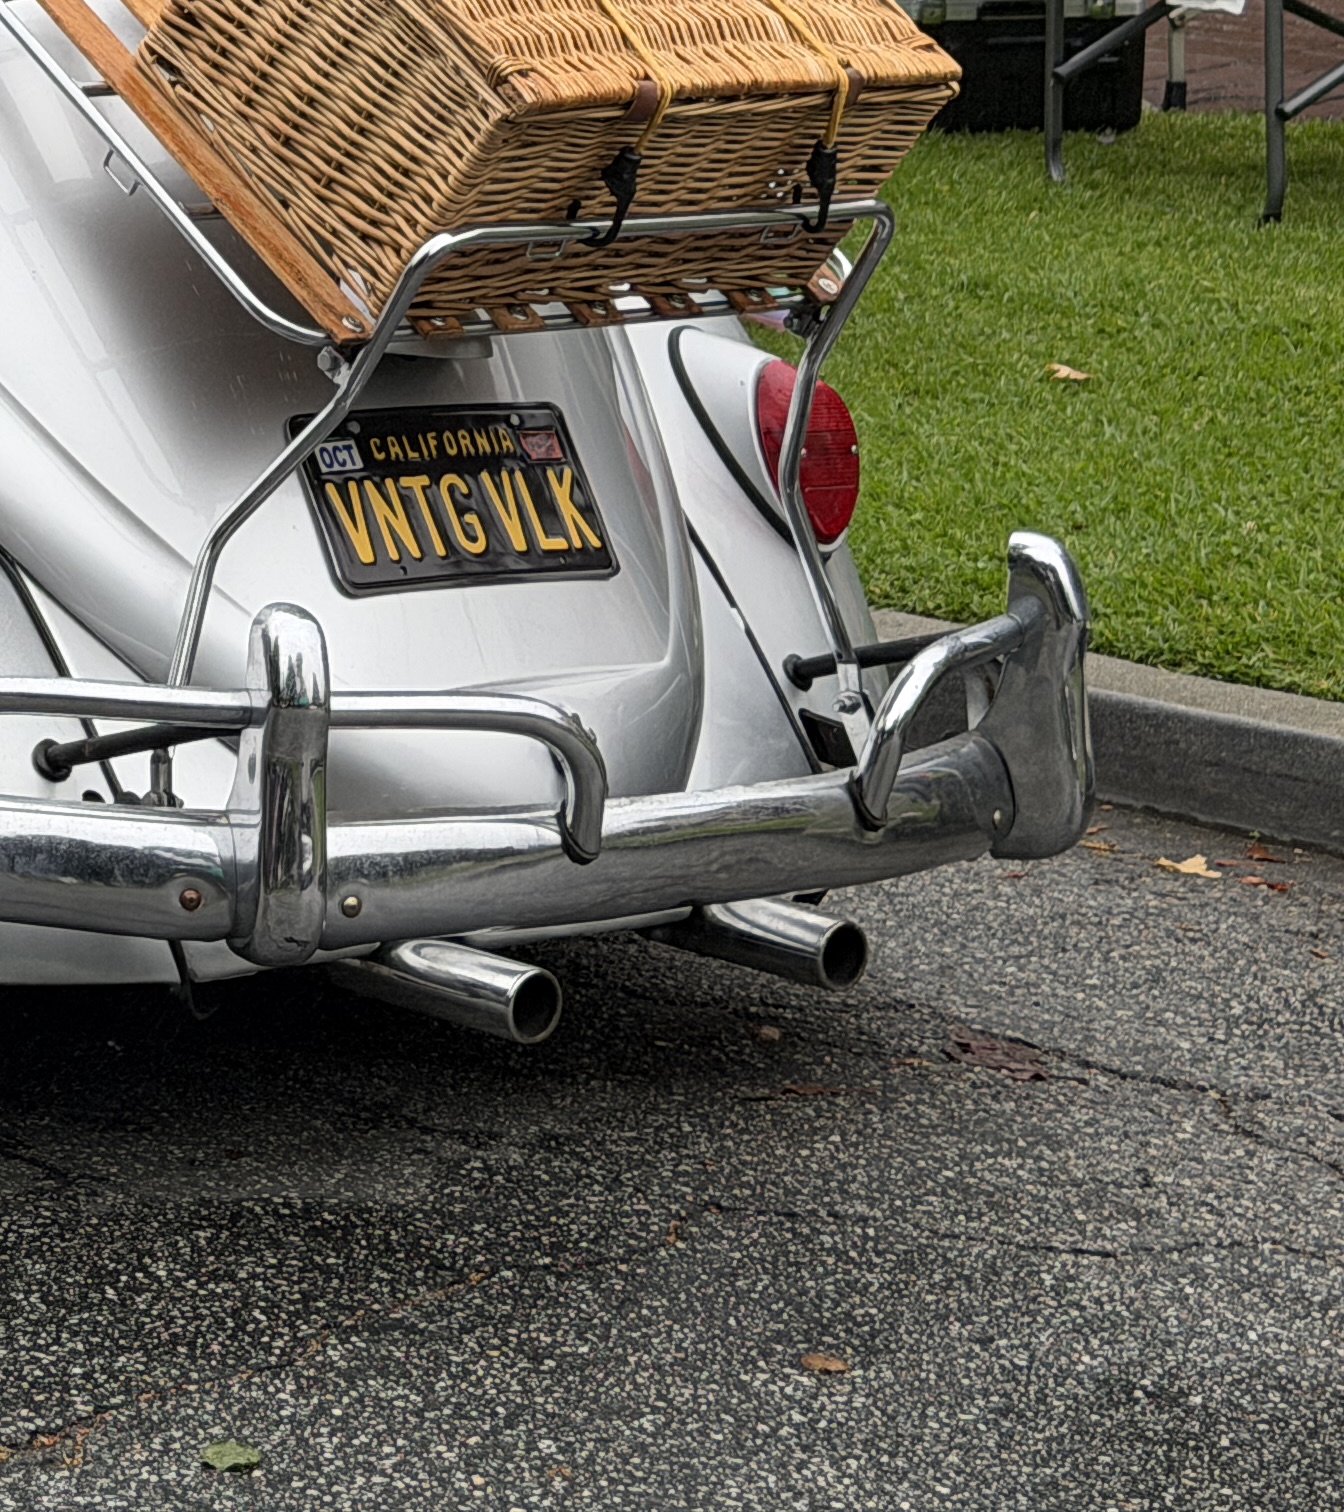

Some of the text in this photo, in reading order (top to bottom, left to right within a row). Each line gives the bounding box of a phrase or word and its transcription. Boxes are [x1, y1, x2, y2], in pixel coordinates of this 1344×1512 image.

[318, 443, 358, 469] OCT
[368, 426, 515, 462] CALIFORNIA
[324, 466, 603, 565] VNTG VLK
